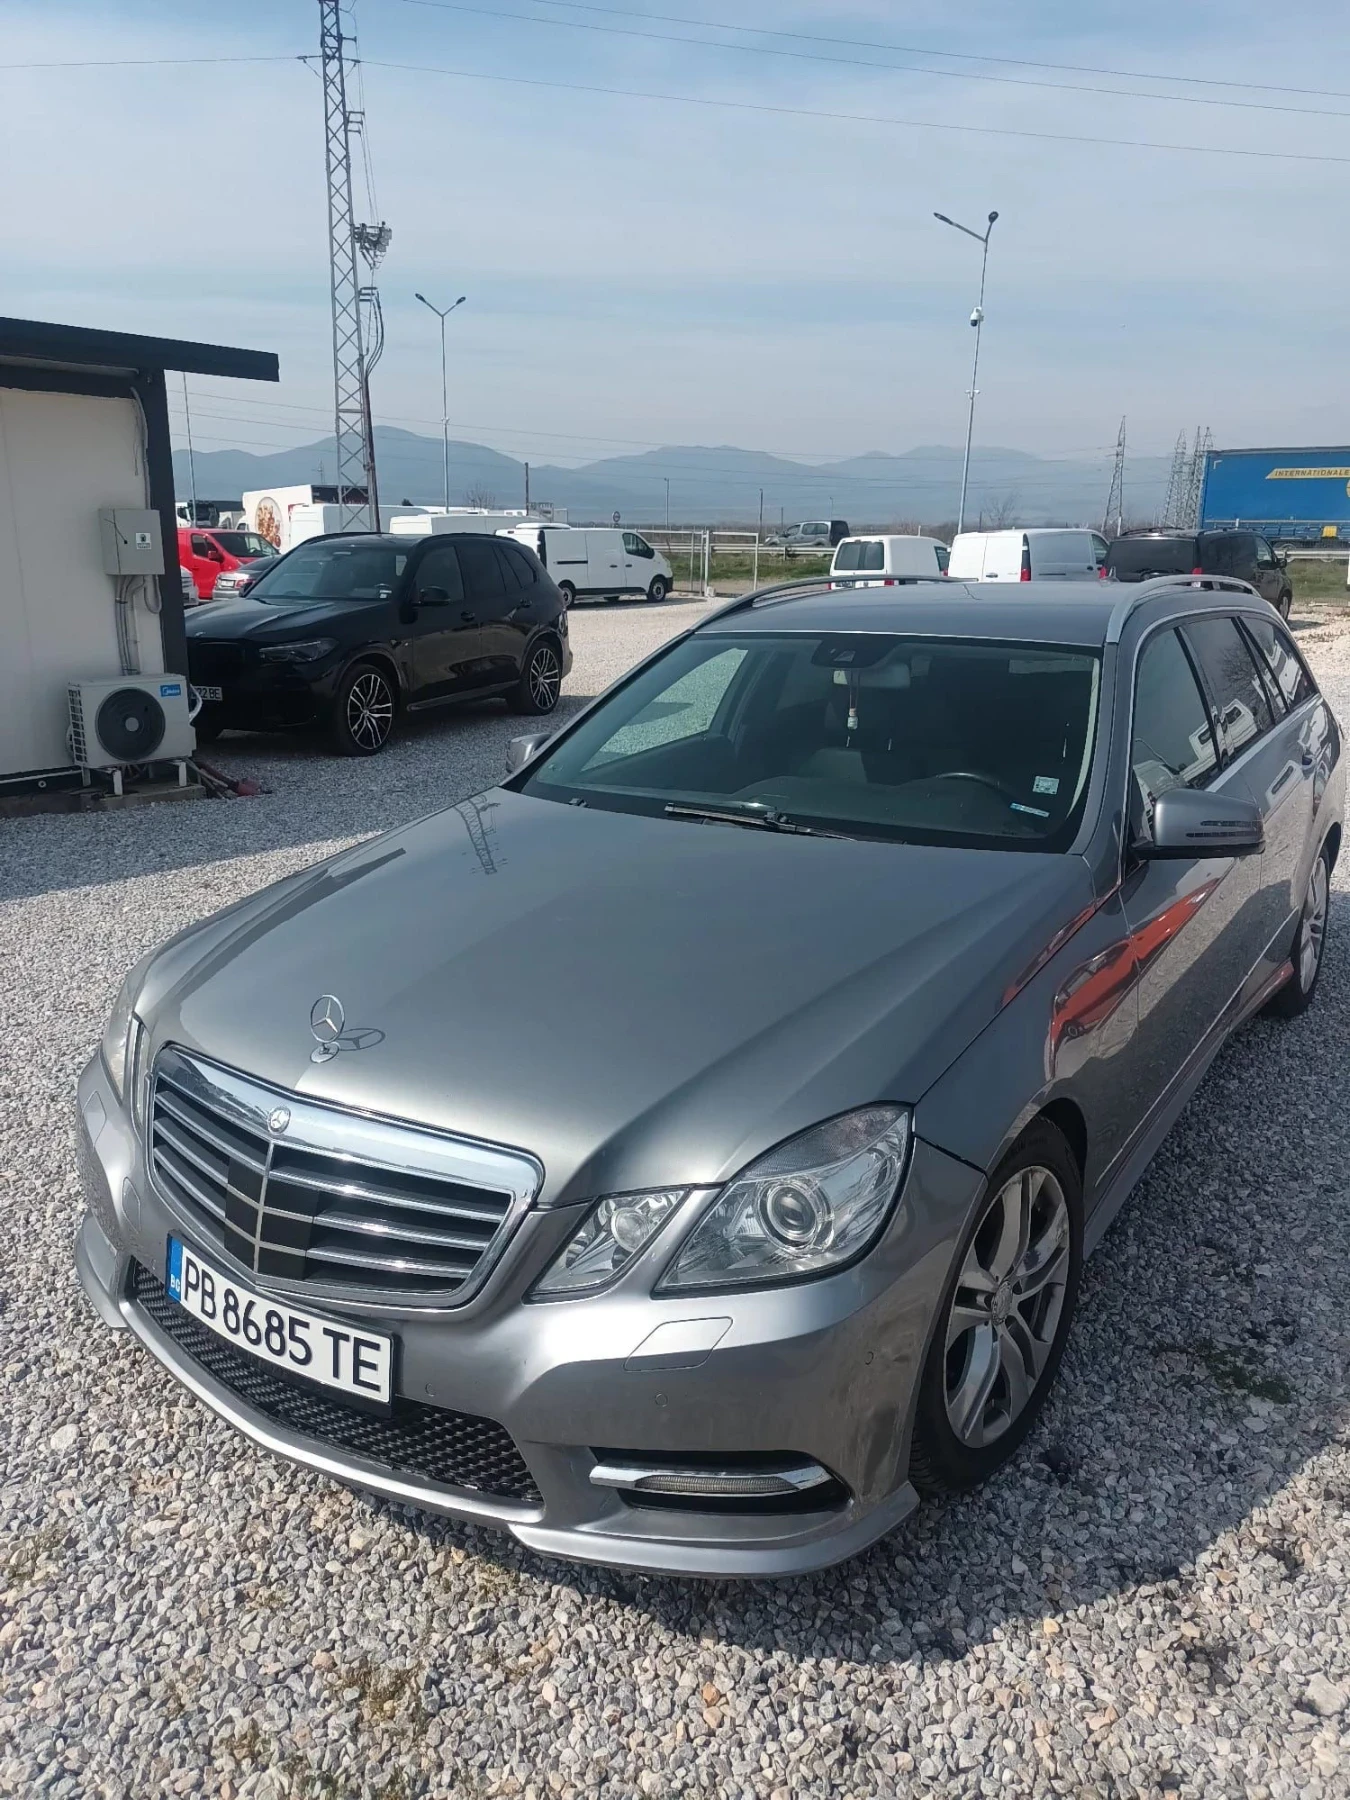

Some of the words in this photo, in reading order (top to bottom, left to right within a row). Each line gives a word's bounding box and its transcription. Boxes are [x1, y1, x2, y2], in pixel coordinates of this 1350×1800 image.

[1274, 469, 1350, 477] INTERNATIONALE
[209, 687, 221, 699] BE
[170, 1273, 181, 1292] BG
[184, 1256, 217, 1320] PB
[223, 1288, 313, 1366] 8685
[323, 1327, 381, 1393] TE
